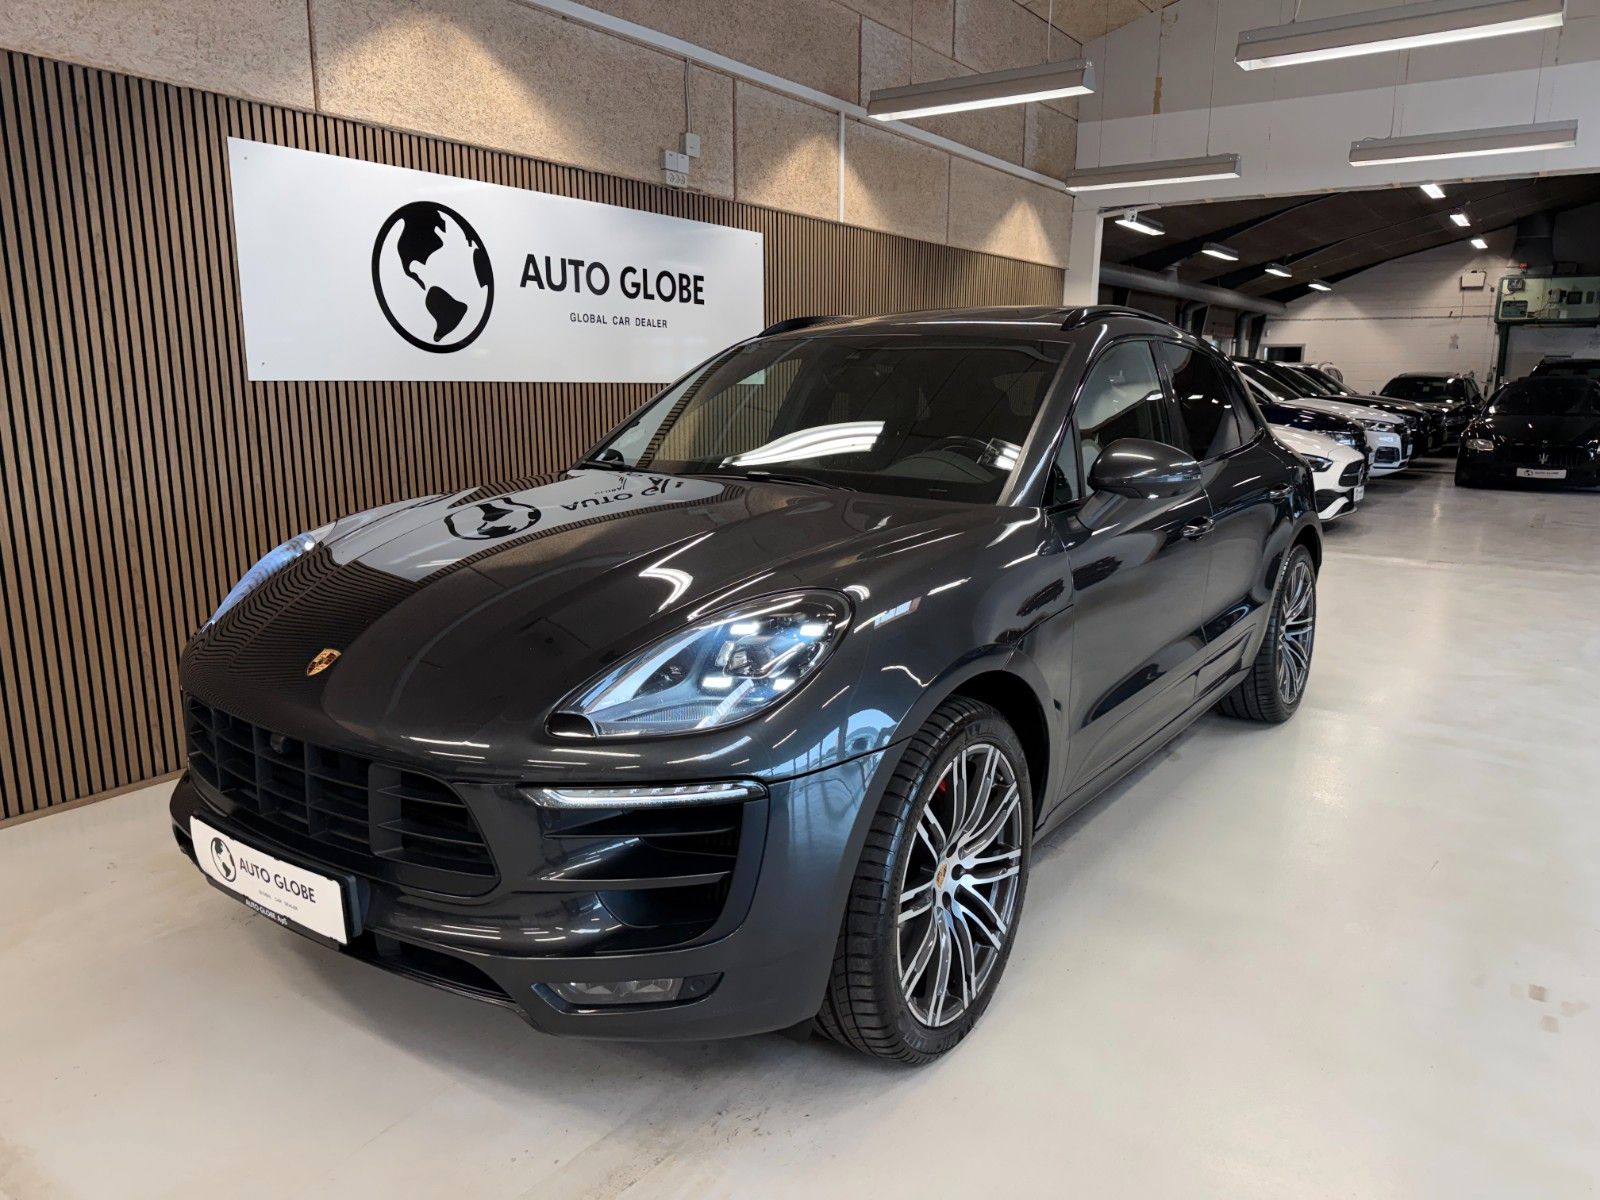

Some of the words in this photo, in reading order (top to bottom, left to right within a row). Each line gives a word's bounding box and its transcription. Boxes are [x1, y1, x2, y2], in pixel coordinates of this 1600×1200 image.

[519, 253, 610, 296] AUTO
[619, 265, 705, 306] GLOBE
[569, 312, 608, 325] GLOBAL
[612, 315, 631, 326] CAR
[635, 317, 668, 329] DEALER
[240, 858, 270, 883] AUTO
[274, 874, 316, 903] GLOBE
